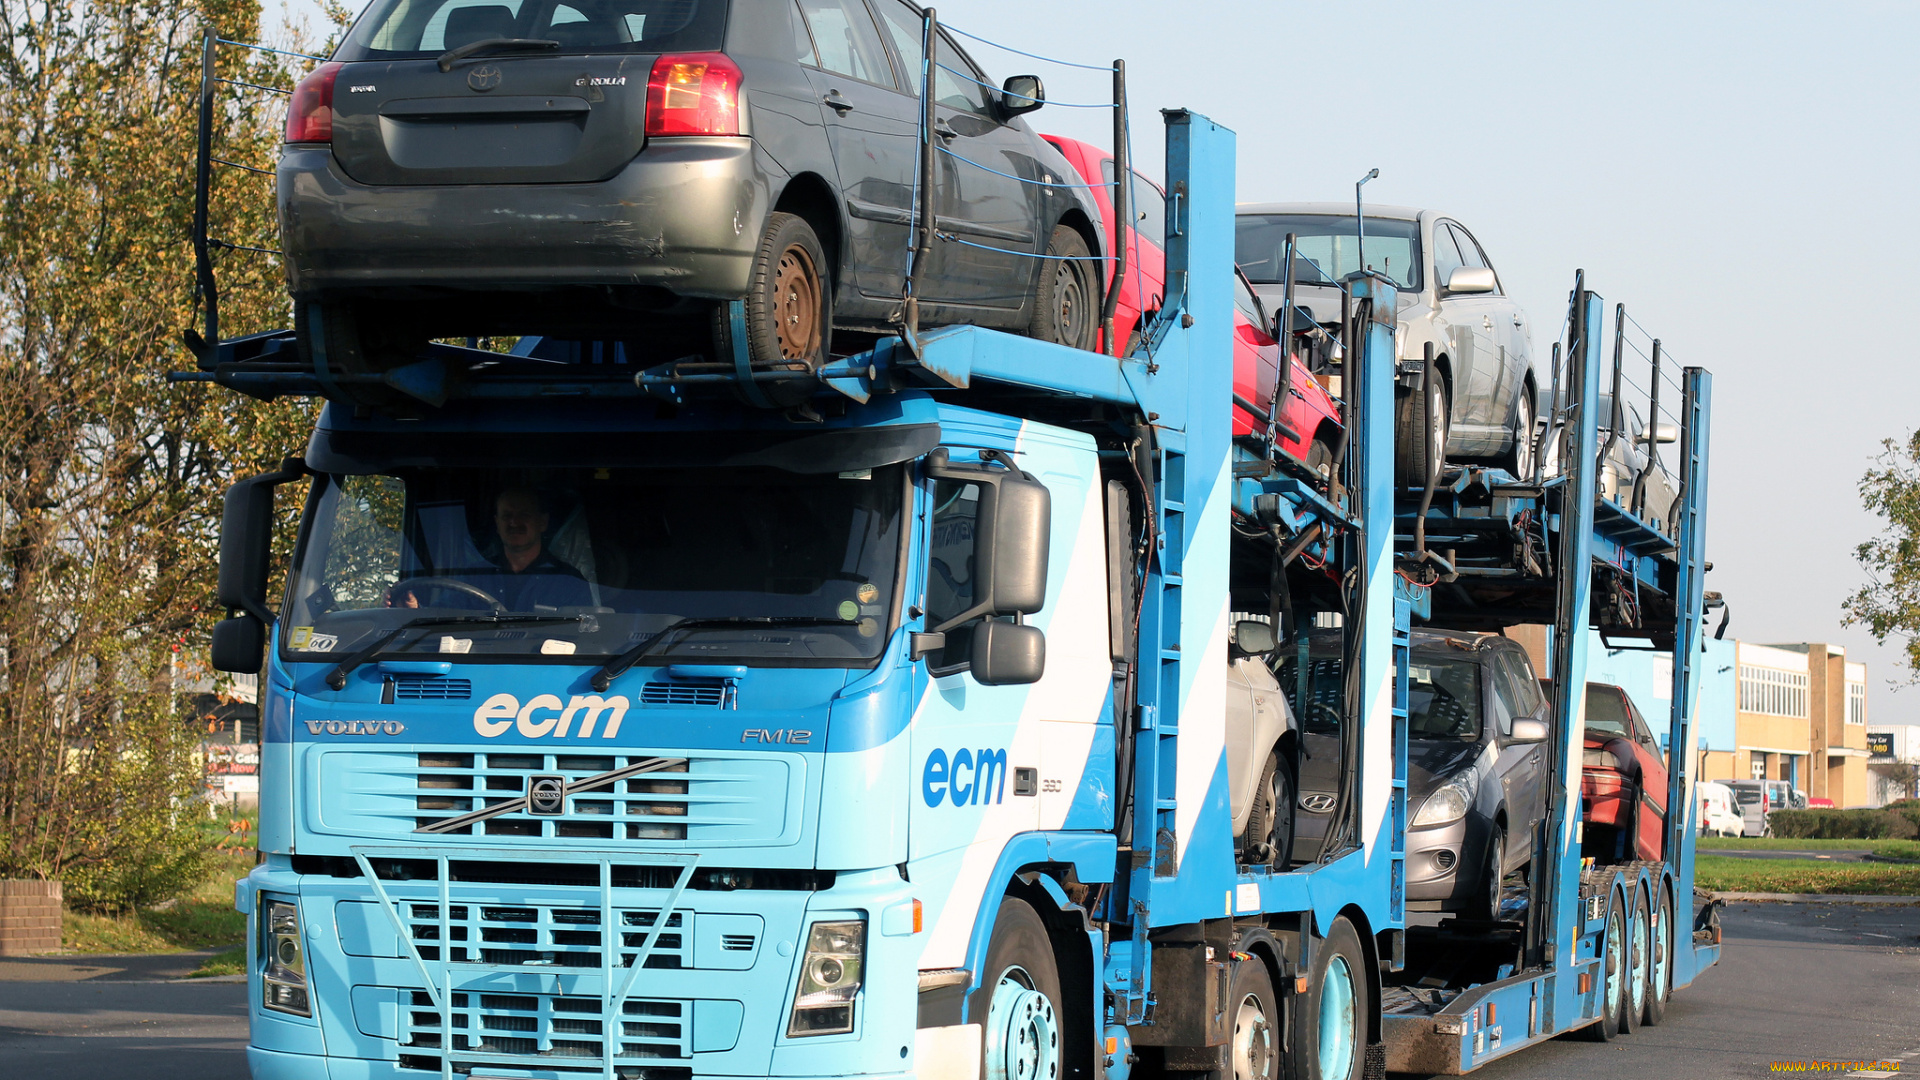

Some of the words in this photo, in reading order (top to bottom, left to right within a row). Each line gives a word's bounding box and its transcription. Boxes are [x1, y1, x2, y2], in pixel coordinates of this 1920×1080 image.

[576, 77, 626, 86] CROLLA
[473, 693, 630, 739] ecm
[304, 719, 405, 736] VOLVO
[230, 763, 257, 773] Now
[922, 748, 1007, 808] ecm
